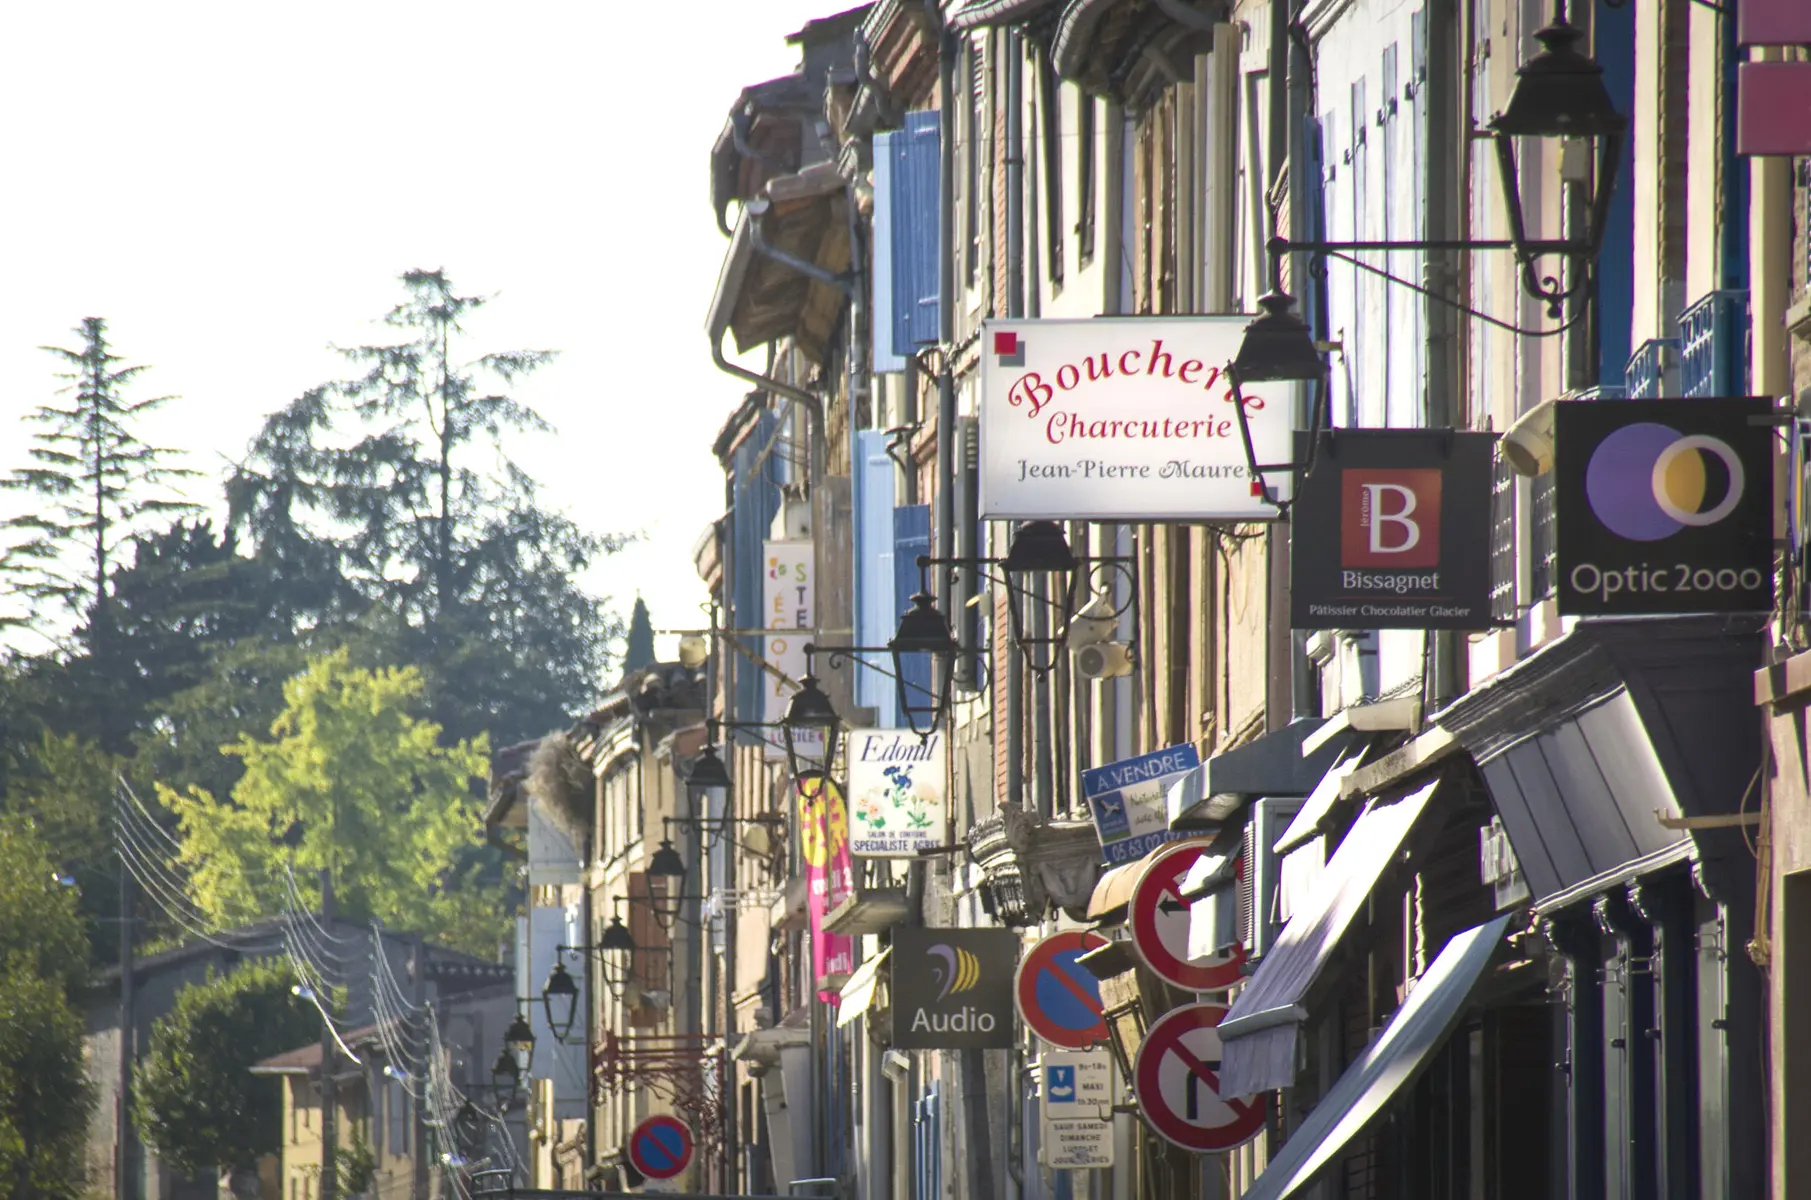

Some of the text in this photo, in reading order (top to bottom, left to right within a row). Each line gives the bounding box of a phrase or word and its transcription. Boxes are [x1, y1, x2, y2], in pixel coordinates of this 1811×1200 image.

[1046, 411, 1232, 444] Charcuterie
[1018, 459, 1253, 481] Jean-Pierre Maure
[1361, 483, 1420, 553] B
[1342, 571, 1440, 594] Bissagnet
[1570, 562, 1763, 602] Optic 2000
[1309, 604, 1471, 617] Pâtissier Chocolatier Glacier
[1111, 752, 1187, 785] VENDRE
[854, 840, 908, 851] SPECIALISTE
[910, 1006, 995, 1033] Audio
